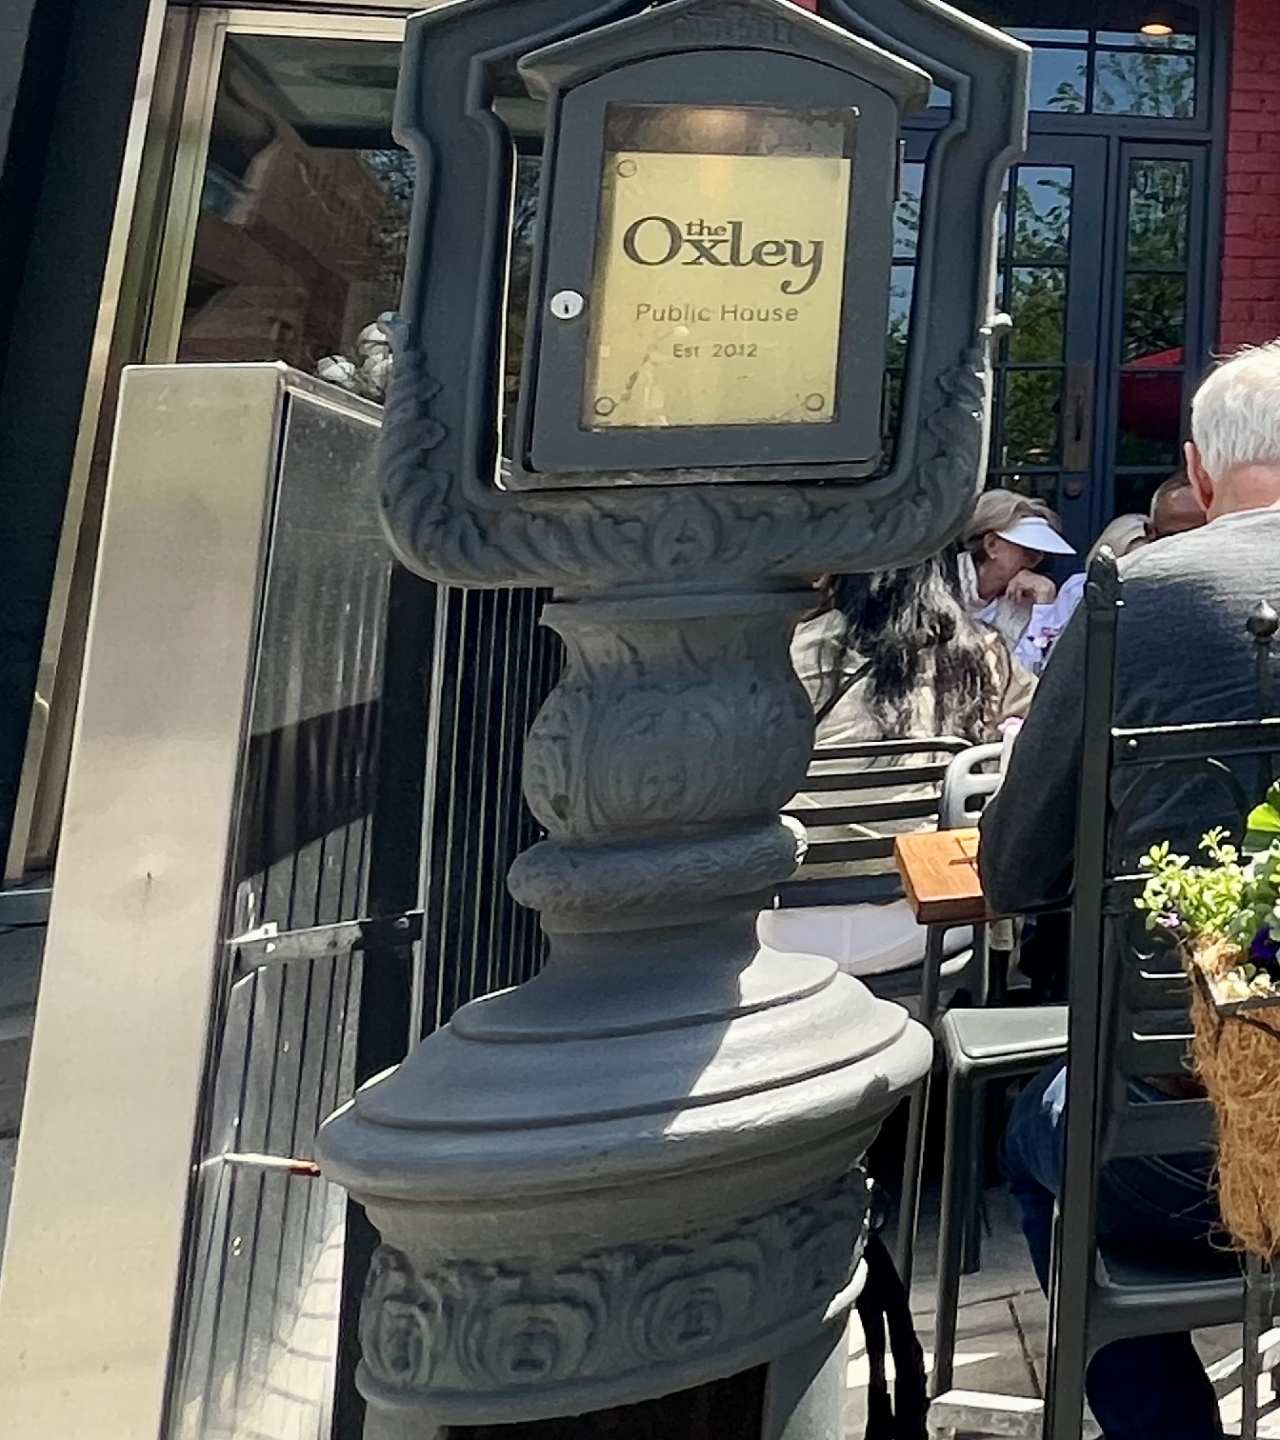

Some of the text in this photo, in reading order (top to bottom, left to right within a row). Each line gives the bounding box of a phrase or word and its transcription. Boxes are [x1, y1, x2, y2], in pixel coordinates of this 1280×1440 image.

[623, 215, 825, 295] the Oxley
[635, 303, 799, 322] Public House
[711, 343, 758, 358] 2012
